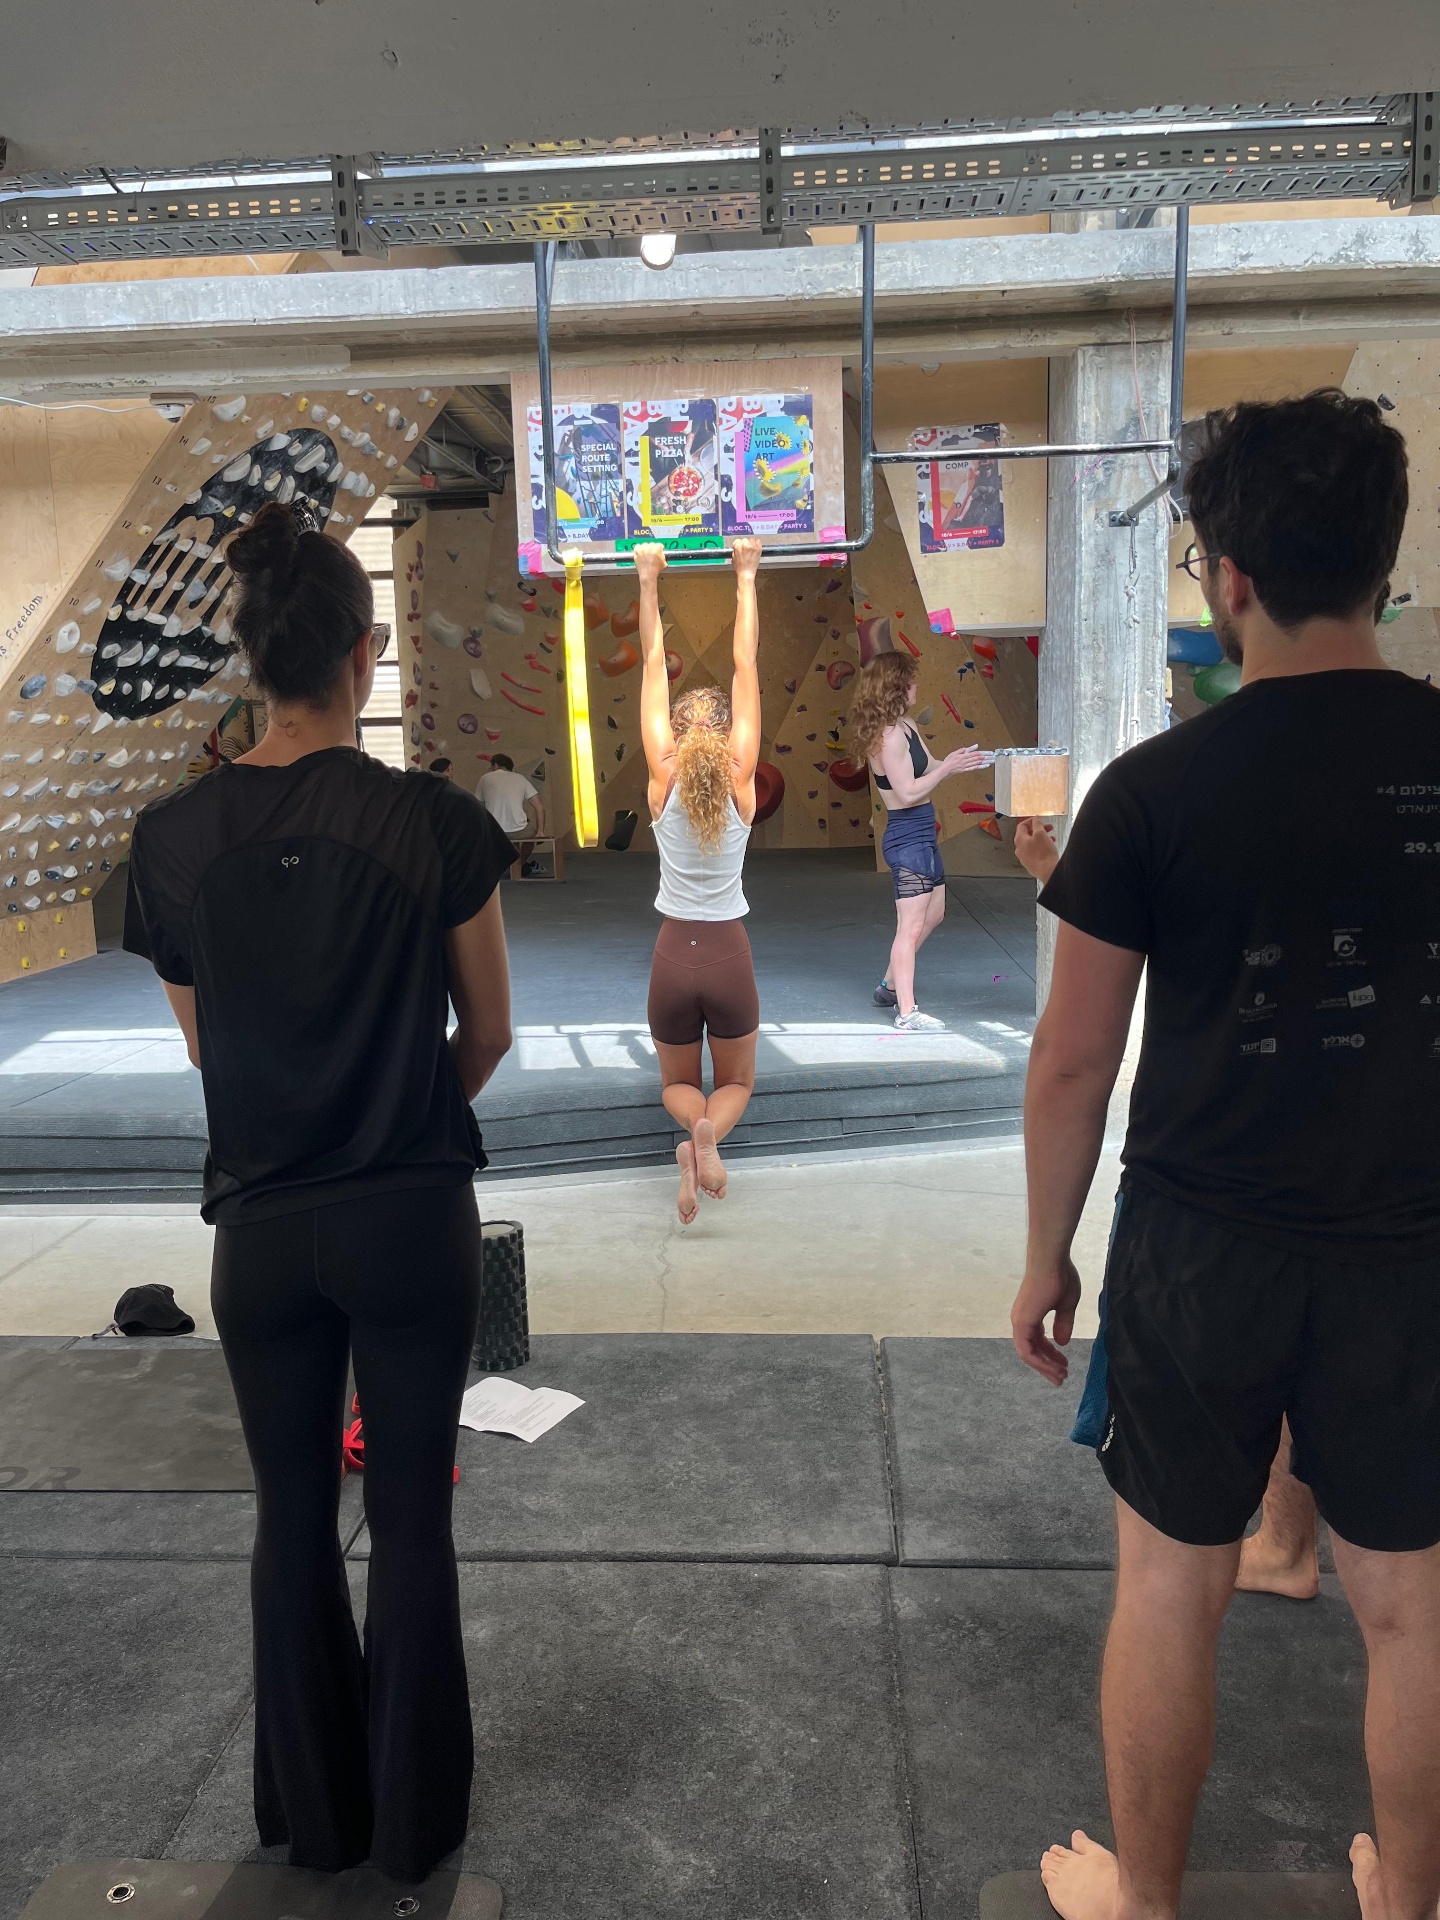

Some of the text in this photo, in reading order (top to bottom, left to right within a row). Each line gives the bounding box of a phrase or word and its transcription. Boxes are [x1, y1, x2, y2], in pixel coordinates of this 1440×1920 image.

[754, 428, 776, 436] LIVE
[655, 436, 687, 446] FRESH
[755, 440, 786, 449] VIDEO
[581, 443, 617, 452] SPECIAL
[655, 449, 684, 458] PIZZA
[755, 452, 775, 461] ART
[581, 454, 611, 463] ROUTE
[582, 464, 618, 473] SETTING
[945, 462, 969, 470] COMP
[122, 520, 132, 529] 12
[69, 597, 80, 606] 10
[5, 594, 43, 641] Freedom
